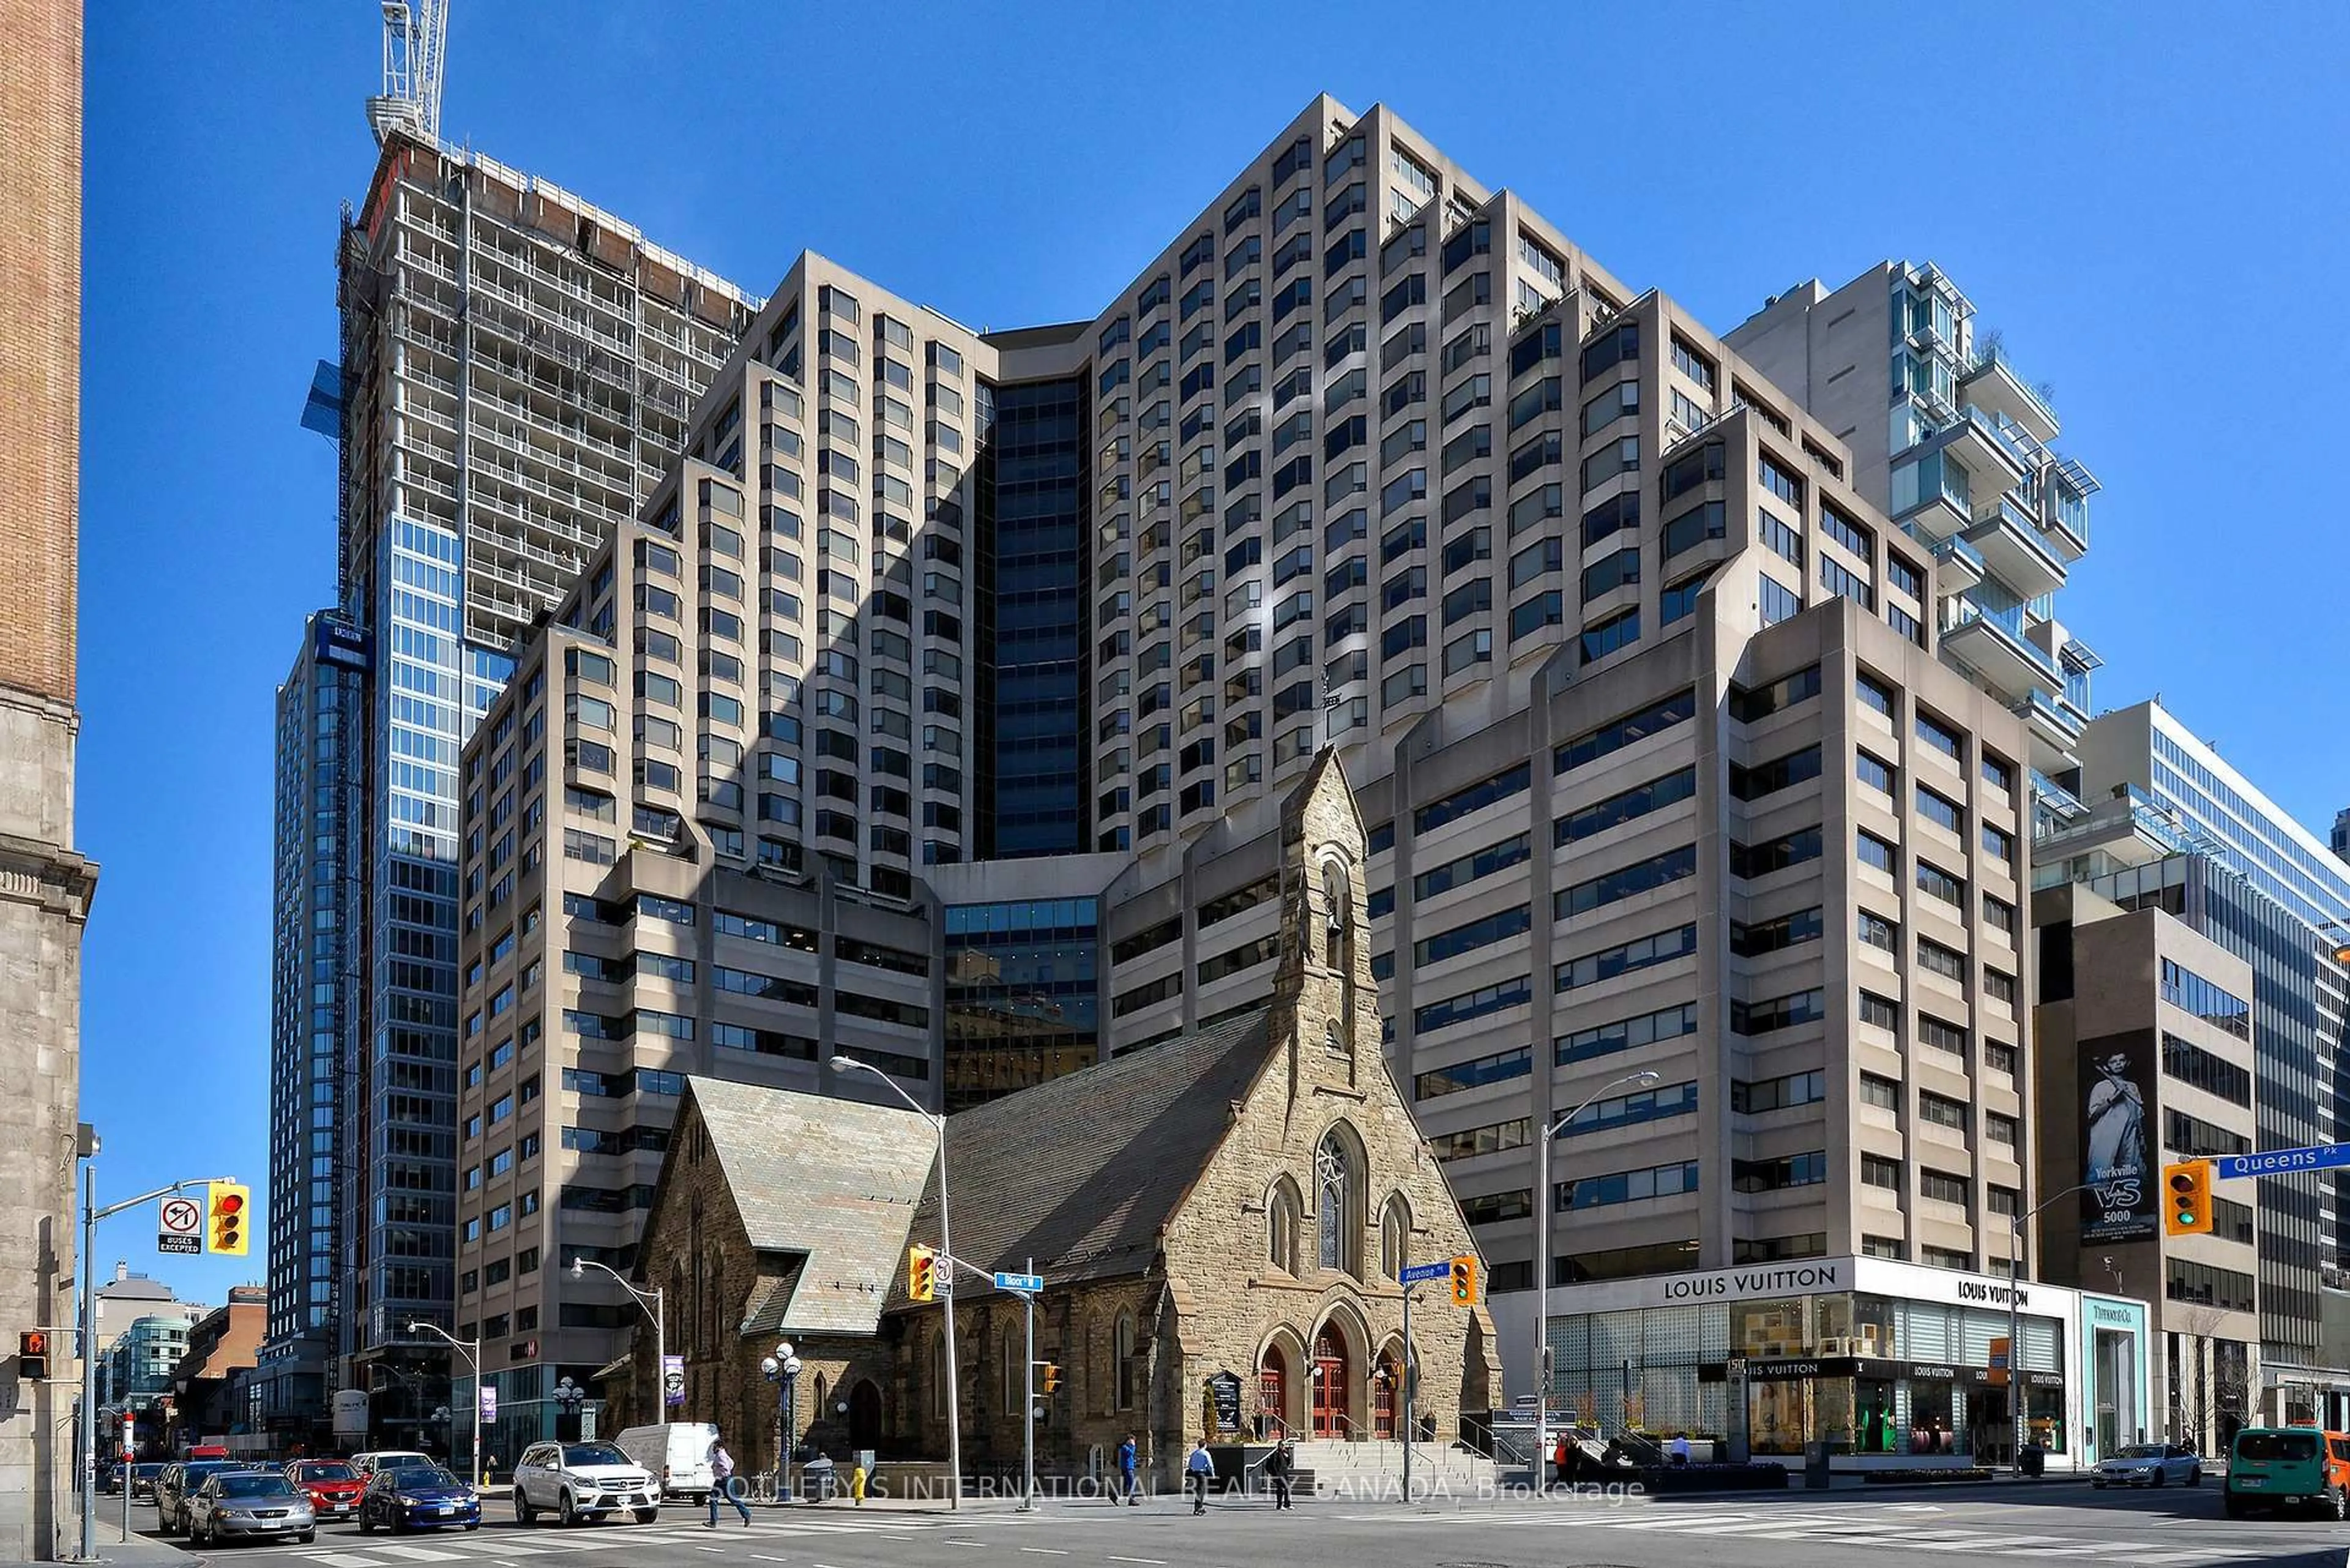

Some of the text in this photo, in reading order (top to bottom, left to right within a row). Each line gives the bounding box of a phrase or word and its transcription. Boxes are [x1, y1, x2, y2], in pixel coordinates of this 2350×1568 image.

[2234, 1151, 2316, 1173] Queens
[2095, 1164, 2138, 1179] Yorkville
[2104, 1210, 2130, 1223] 5000
[160, 1244, 198, 1252] EXCEPTED
[1005, 1275, 1022, 1286] Bloor
[1665, 1266, 1835, 1299] LOUIS VUITTON
[1958, 1281, 2027, 1307] LOUIS VUITON
[1767, 1364, 1818, 1375] VUITTON
